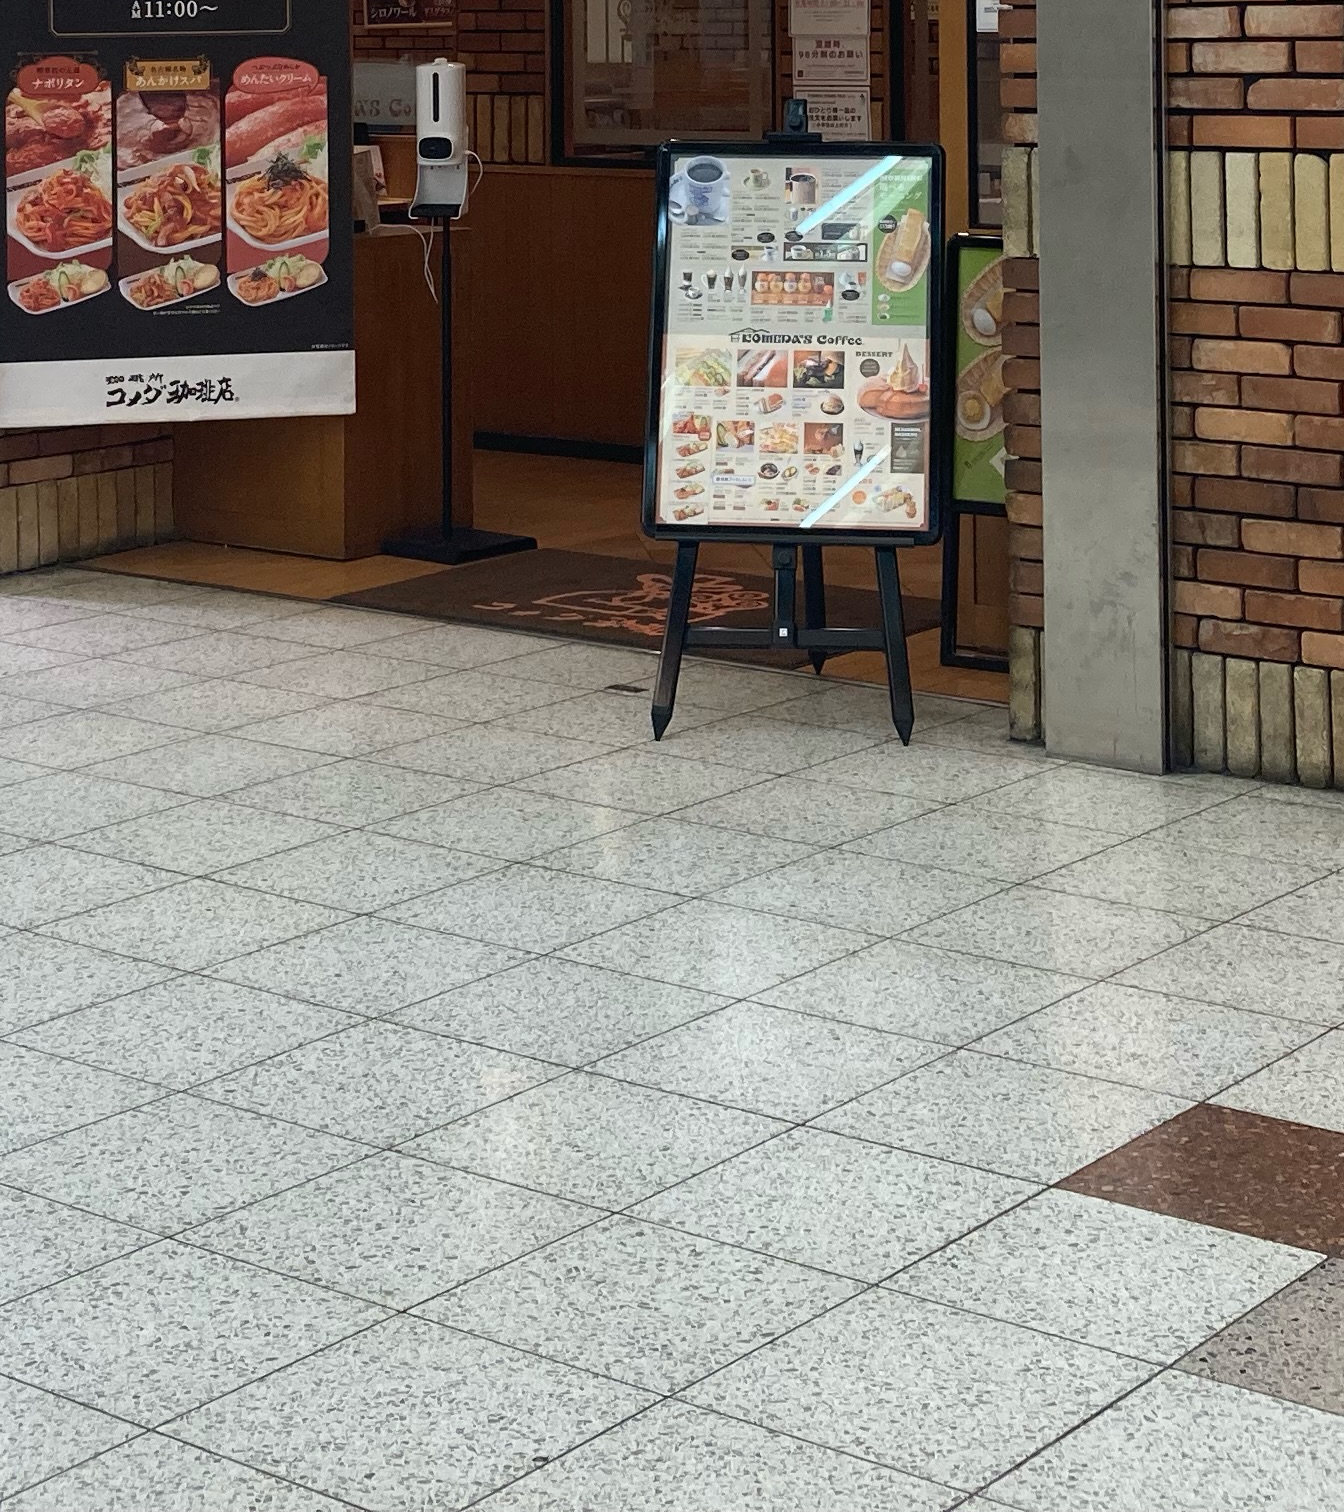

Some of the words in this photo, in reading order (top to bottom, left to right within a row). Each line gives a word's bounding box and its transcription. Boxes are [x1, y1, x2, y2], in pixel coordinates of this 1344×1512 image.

[31, 77, 85, 90] ナポリタン
[240, 73, 313, 85] めんたいクリーム
[106, 376, 234, 407] コメダ珈琲店
